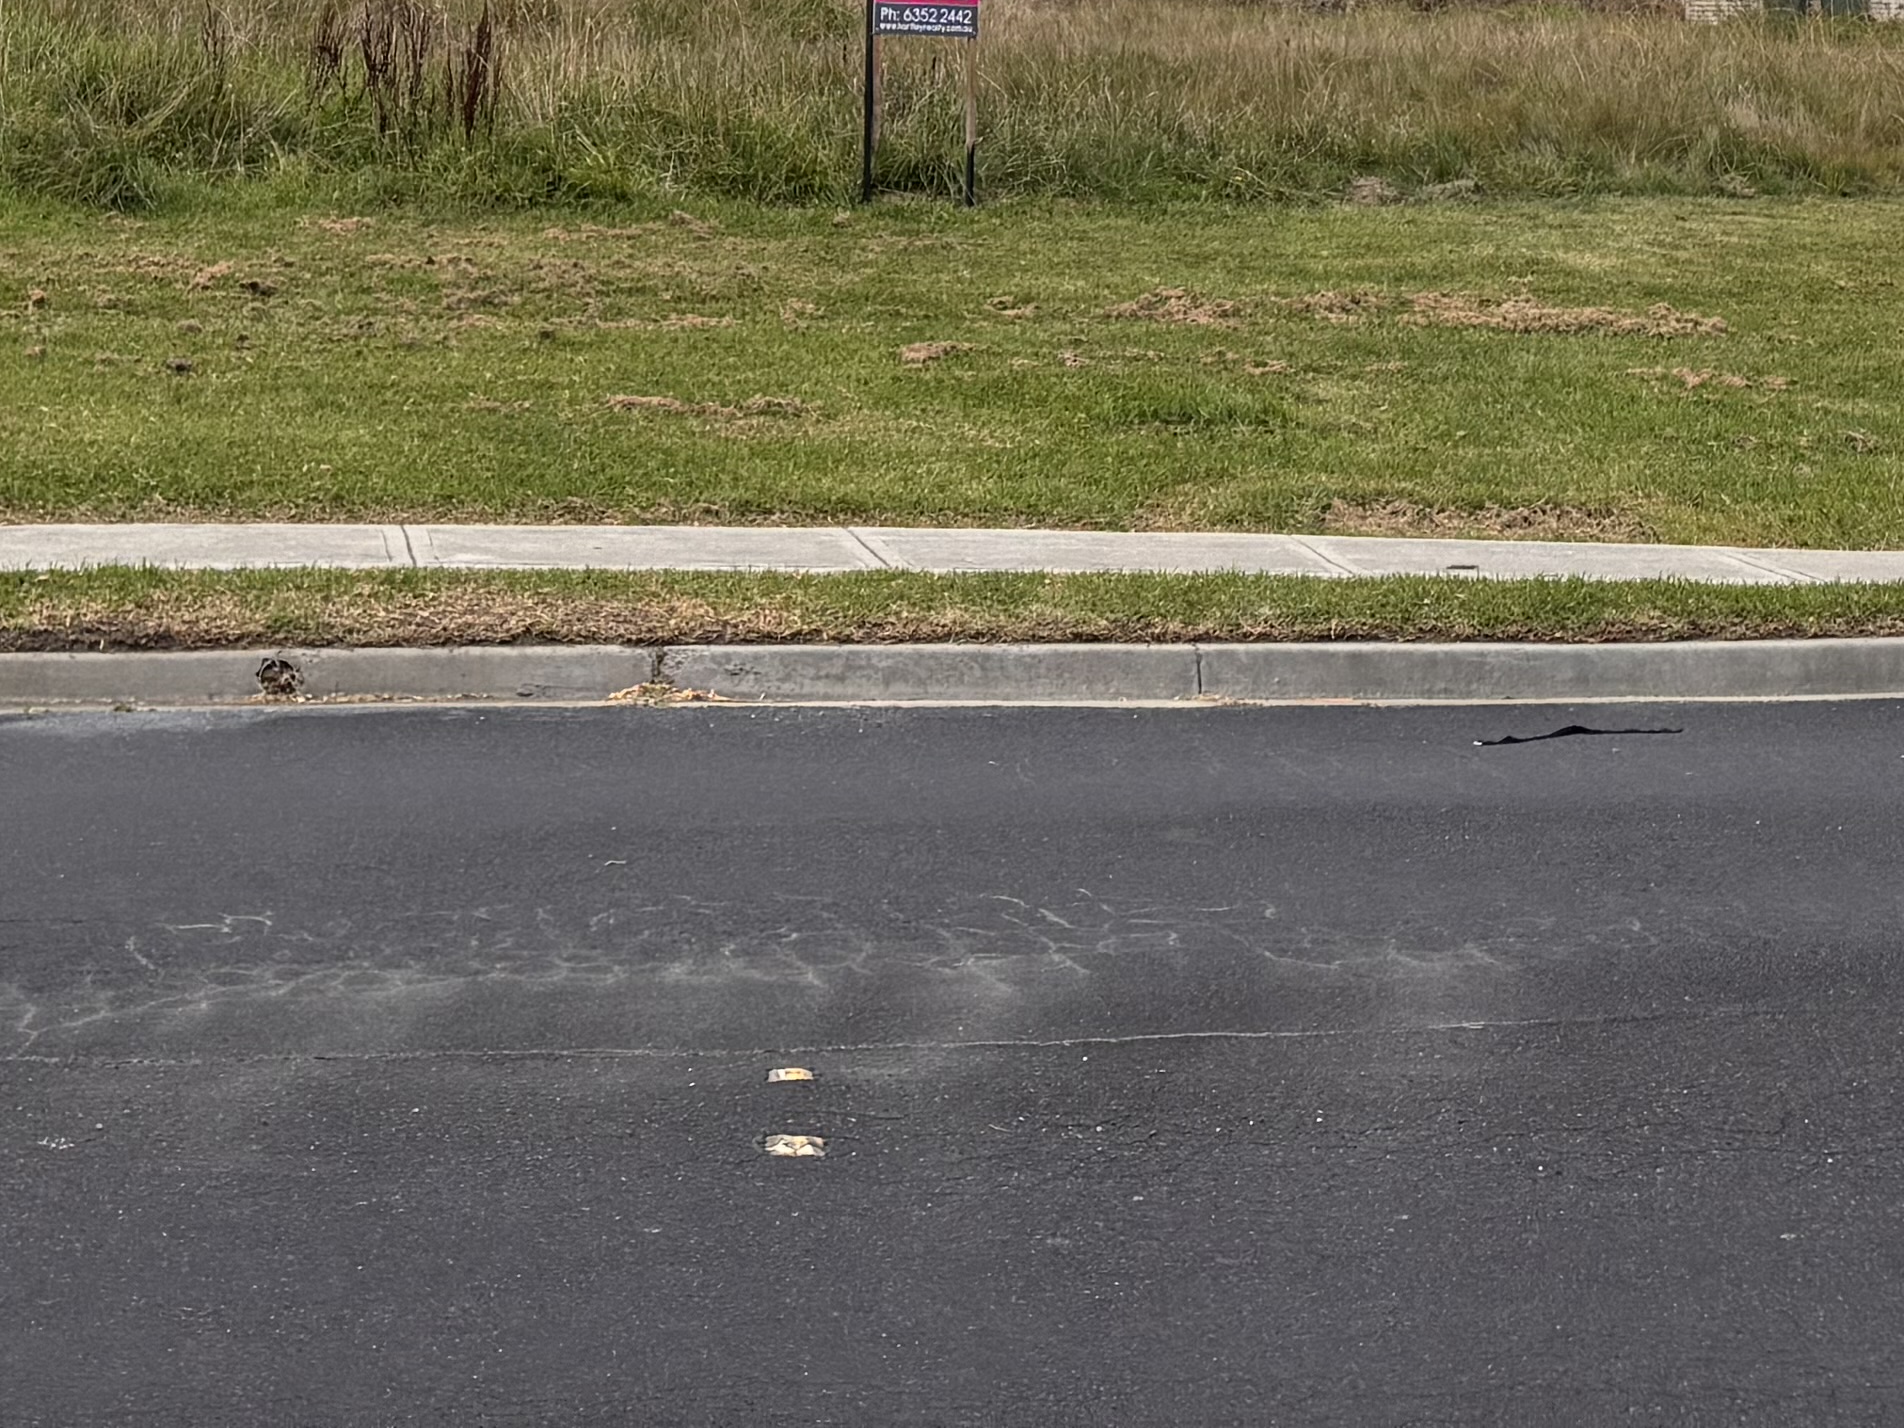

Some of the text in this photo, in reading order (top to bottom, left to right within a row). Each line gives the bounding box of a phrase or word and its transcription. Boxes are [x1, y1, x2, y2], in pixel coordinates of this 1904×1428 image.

[880, 7, 973, 24] Ph: 6352 2442
